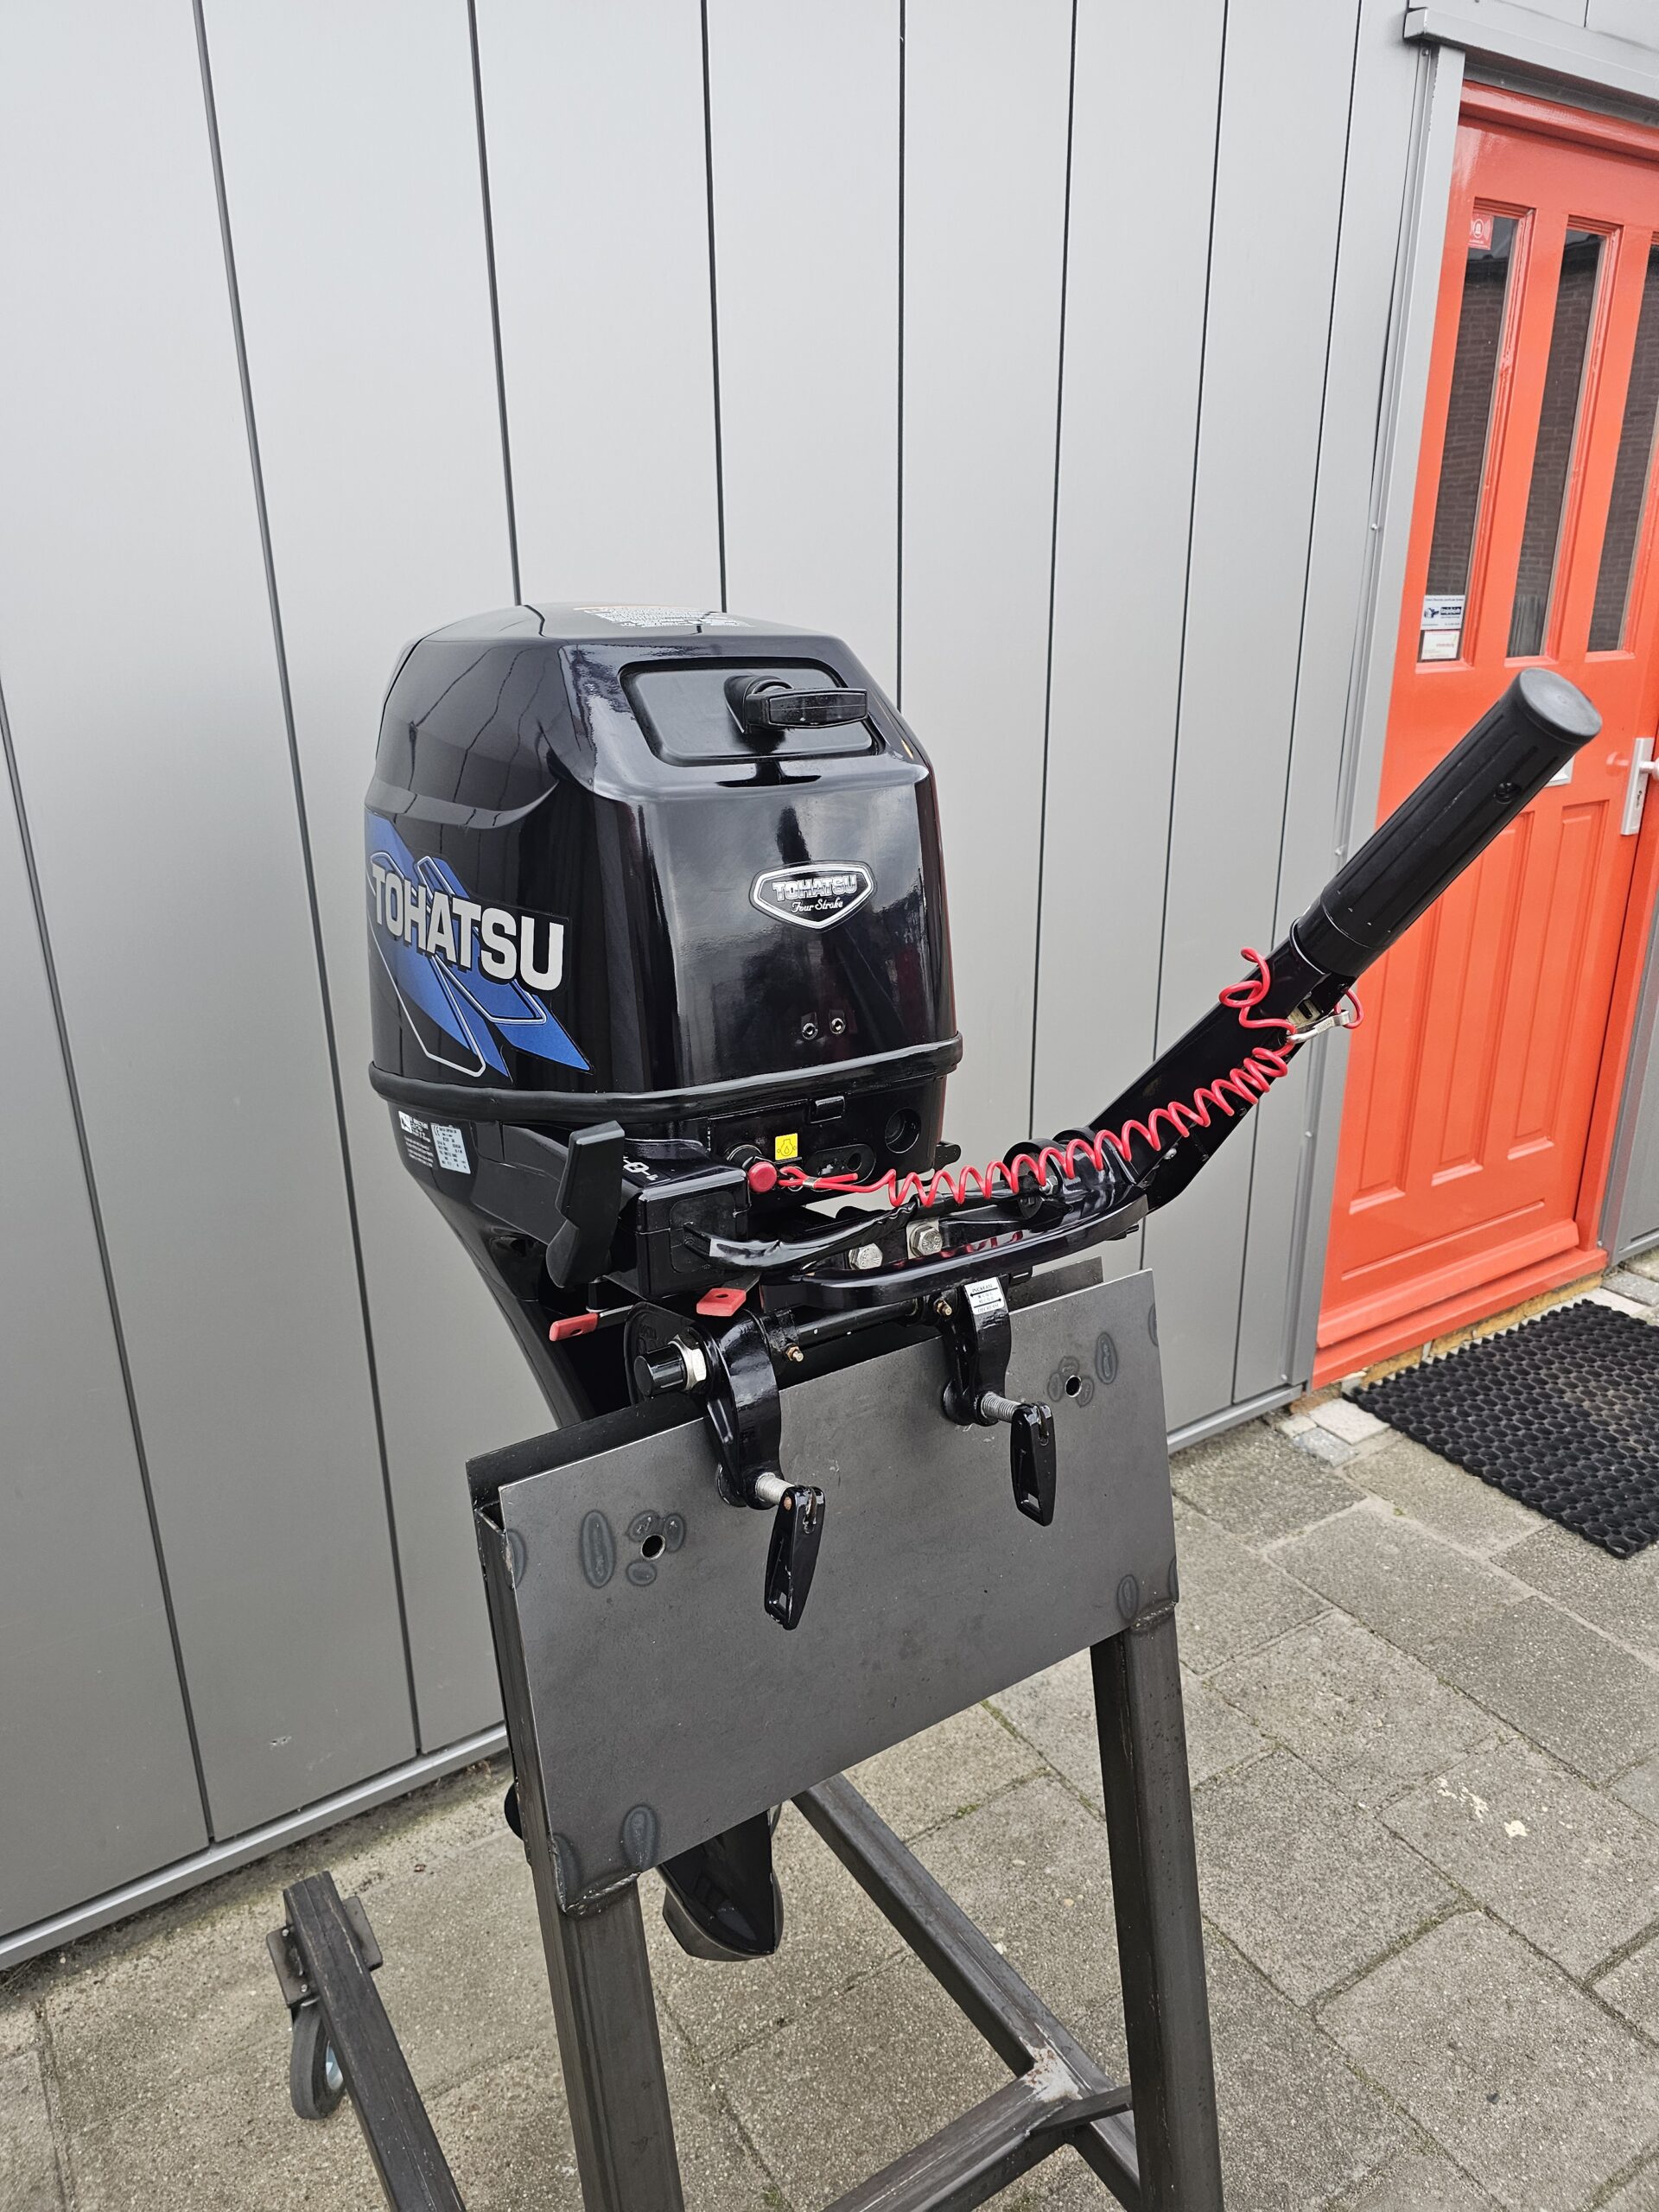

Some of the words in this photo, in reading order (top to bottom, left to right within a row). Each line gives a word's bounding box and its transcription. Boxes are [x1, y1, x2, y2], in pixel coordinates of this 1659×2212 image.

[772, 874, 857, 901] TOHATSU
[791, 901, 814, 913] Four
[372, 863, 564, 991] TOHATSU
